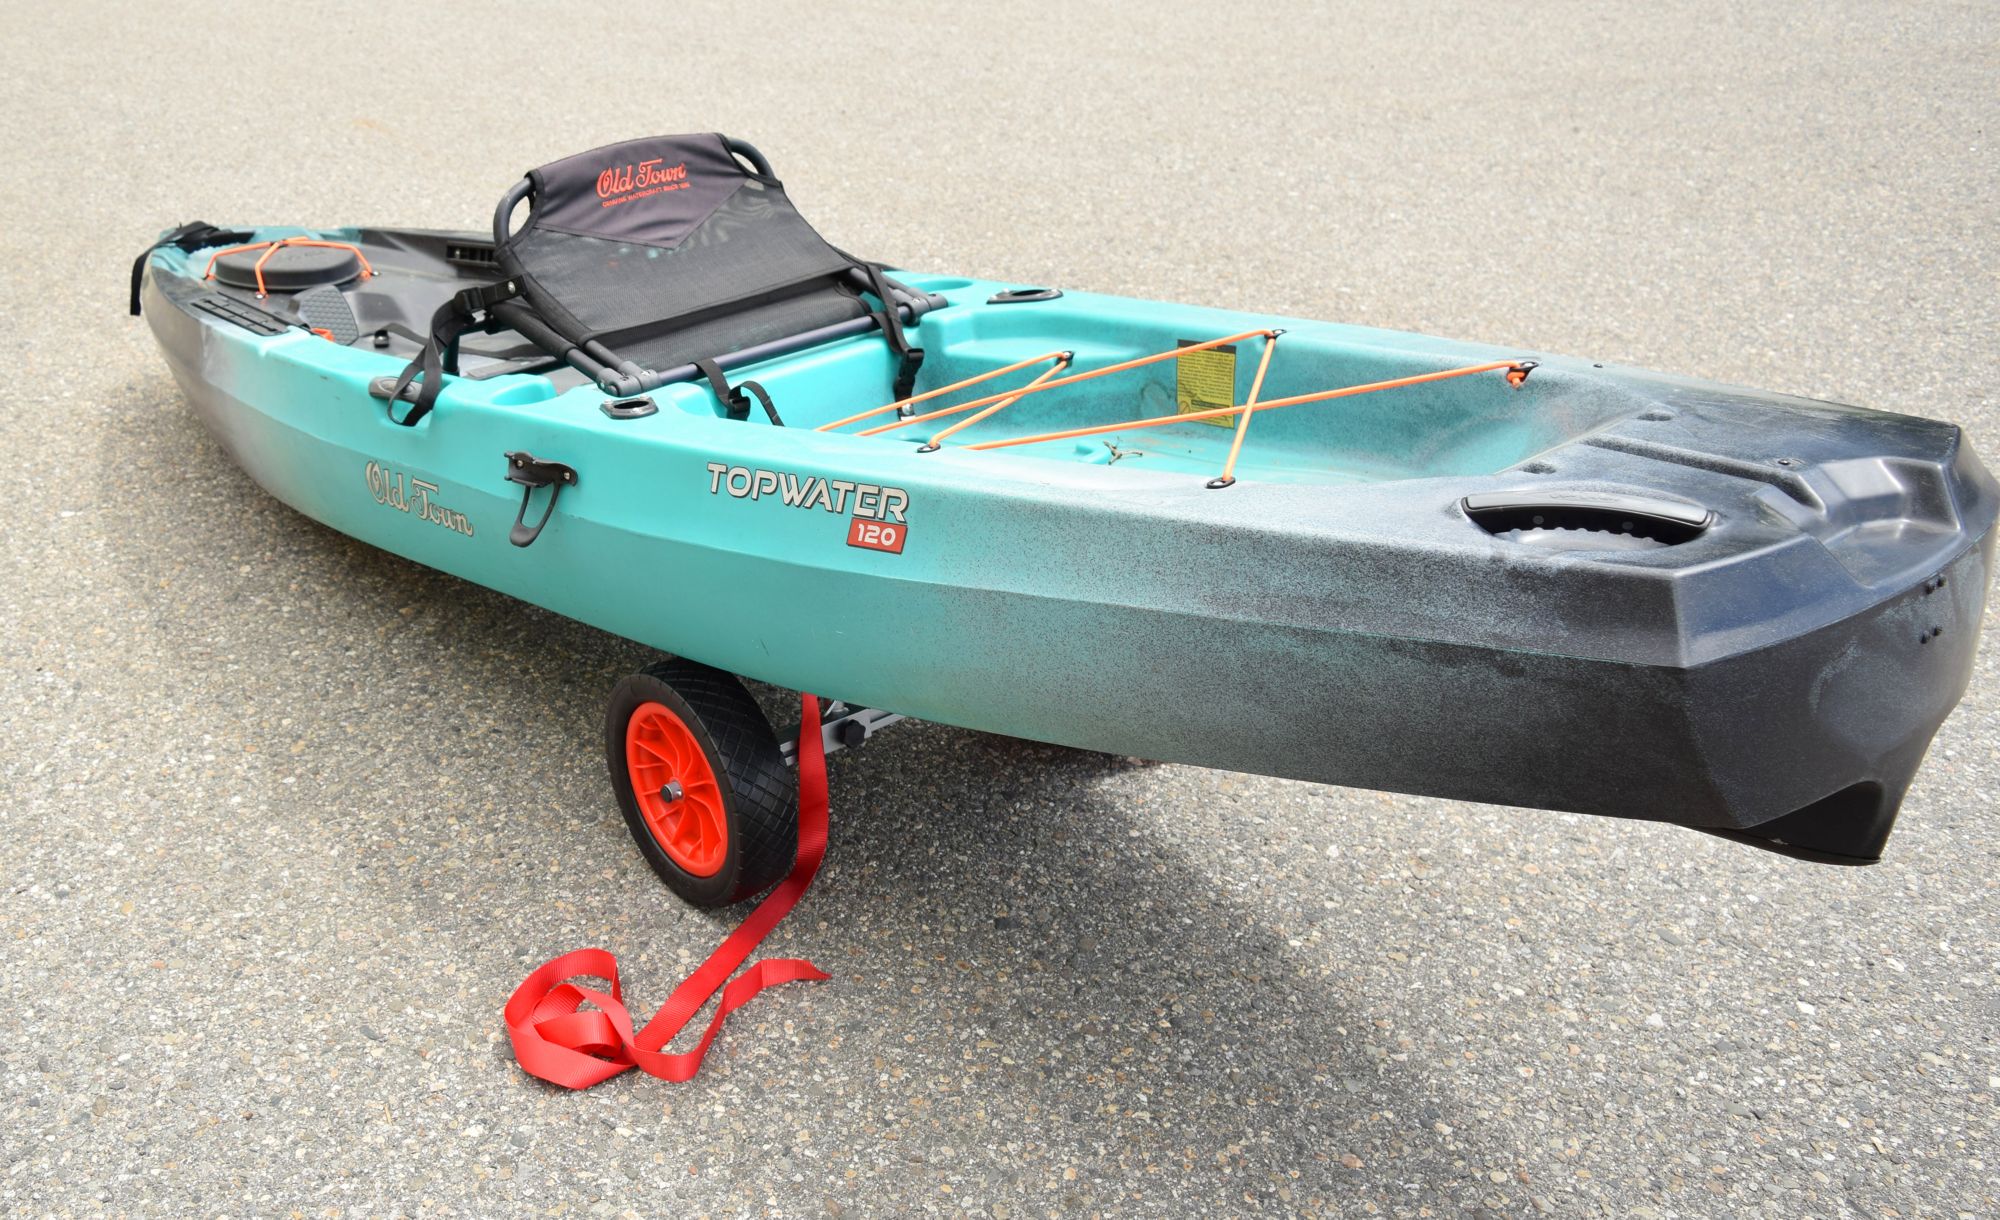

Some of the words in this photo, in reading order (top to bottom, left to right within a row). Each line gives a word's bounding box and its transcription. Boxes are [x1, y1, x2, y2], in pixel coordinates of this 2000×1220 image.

[596, 164, 634, 198] Old
[635, 158, 686, 188] Town
[365, 460, 409, 513] Old
[411, 476, 474, 537] Town
[707, 462, 909, 524] TOPWATER
[857, 522, 896, 547] 120
